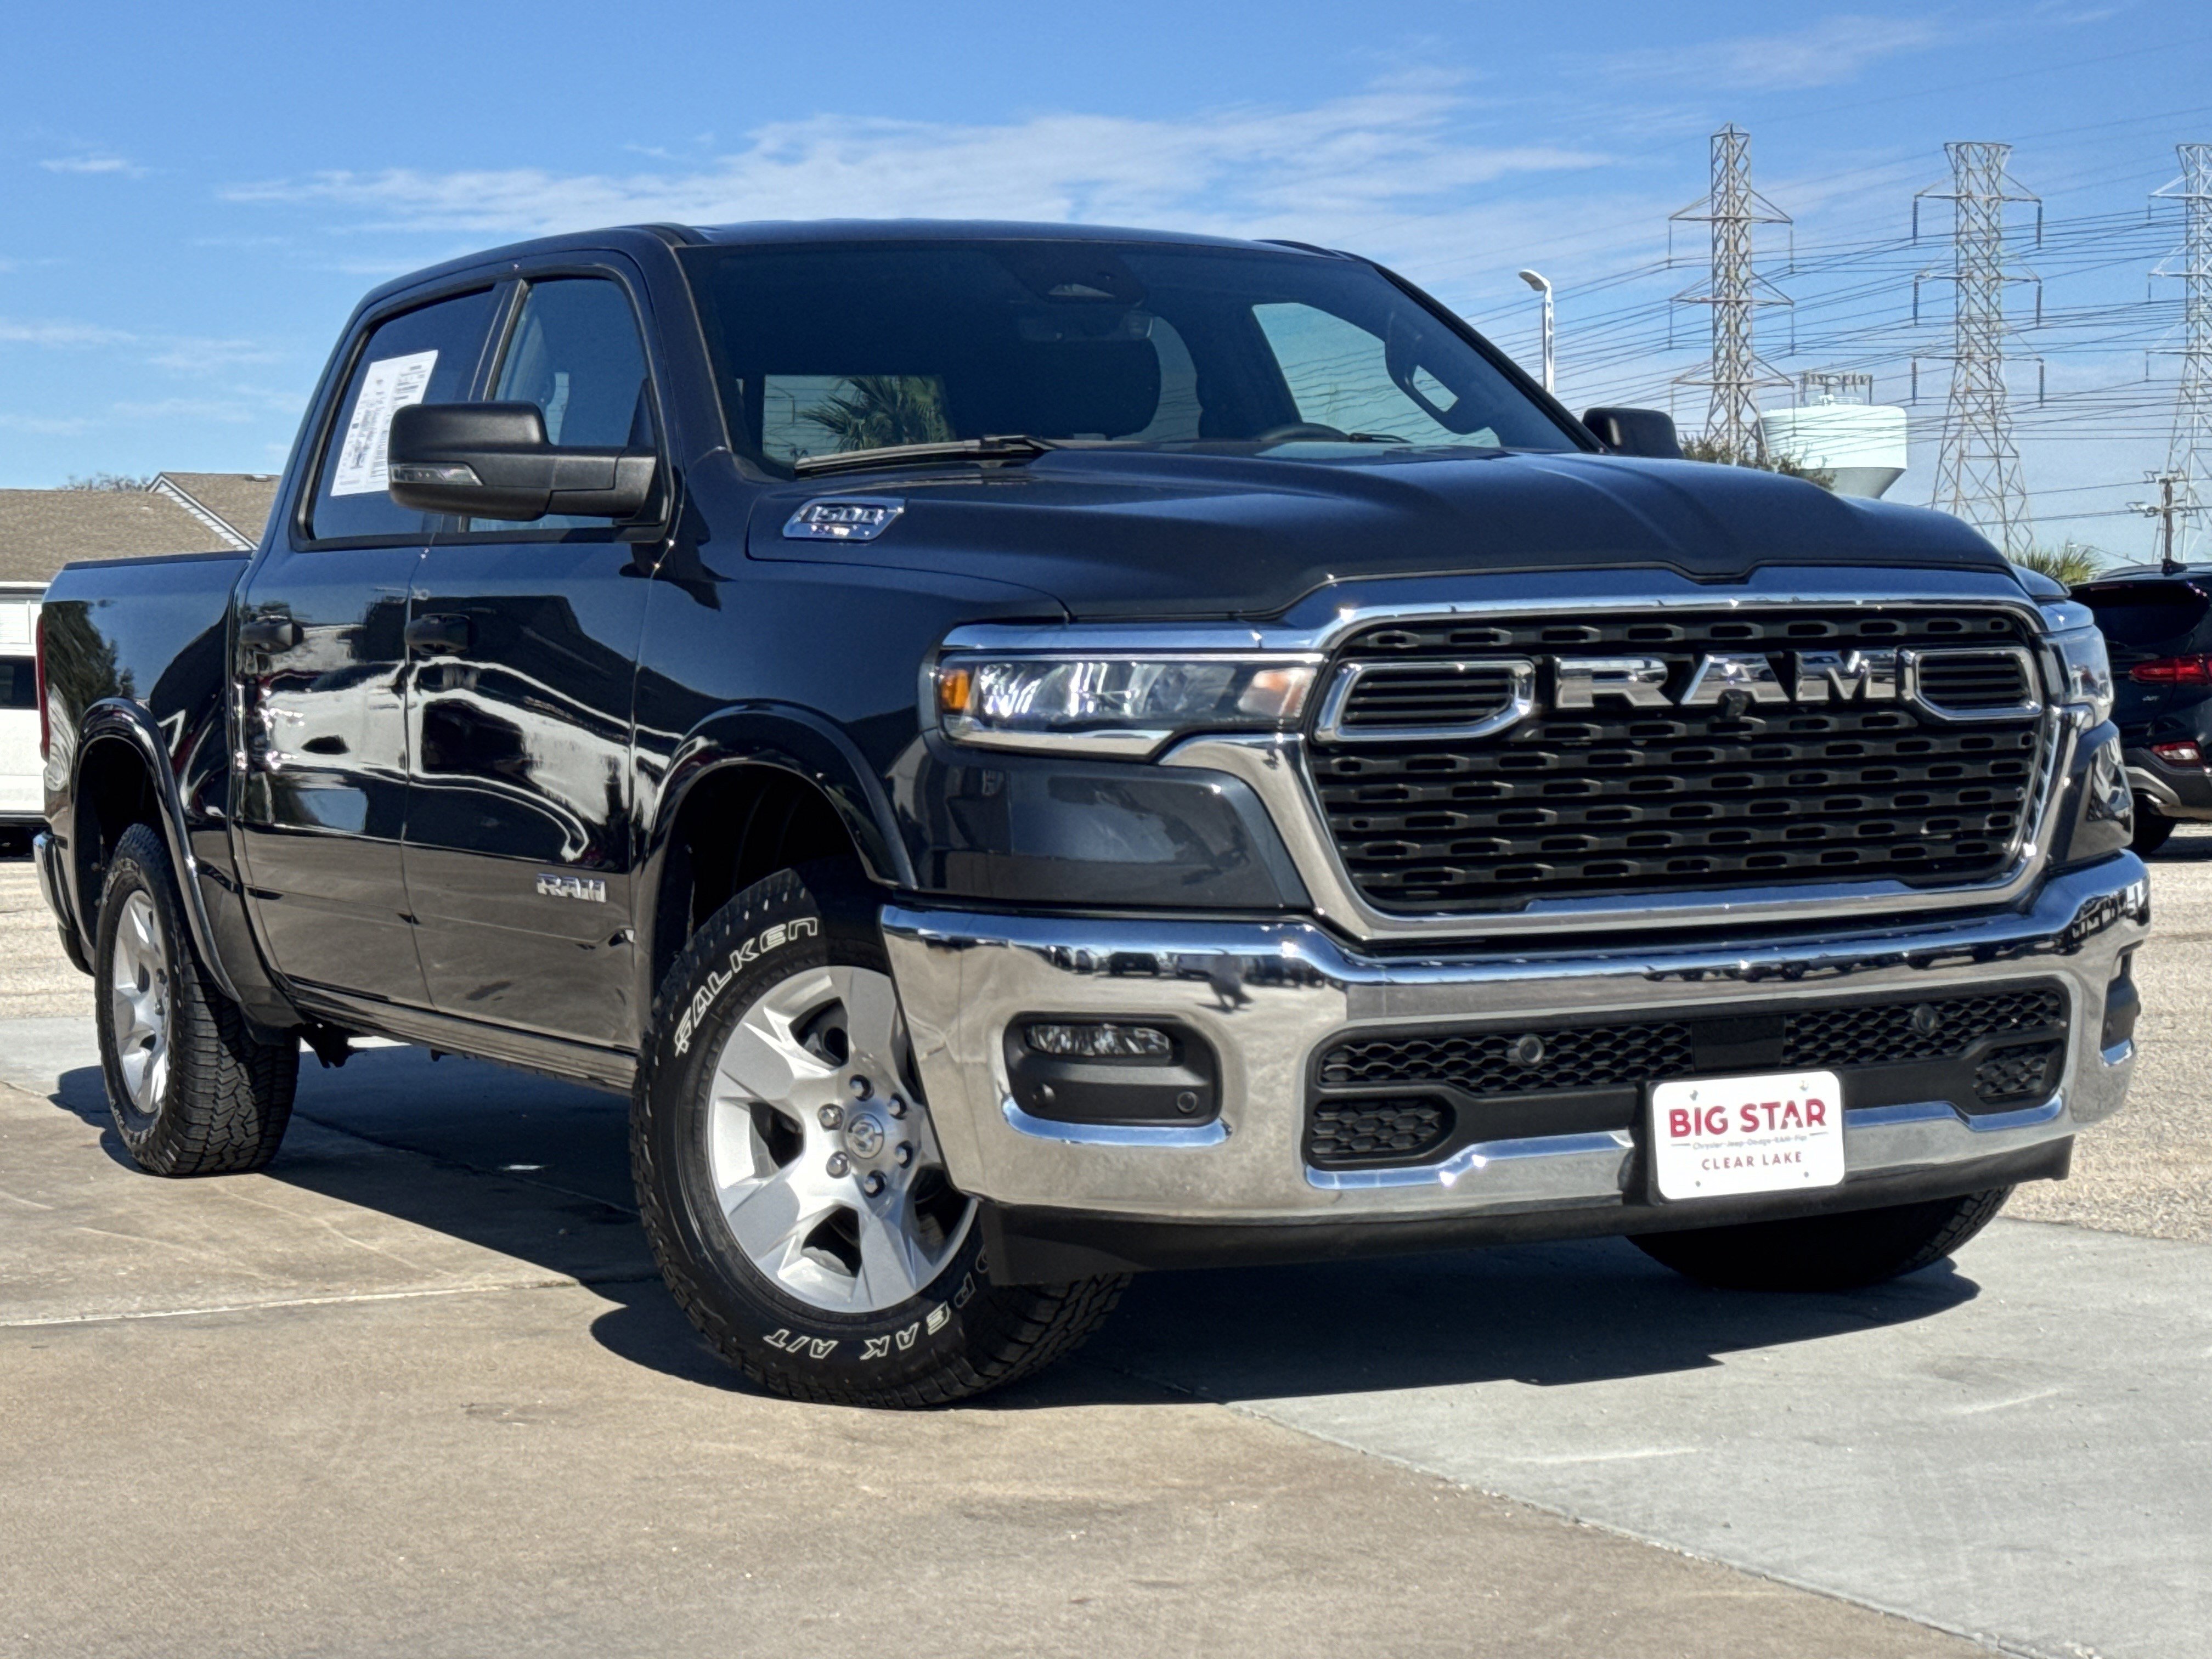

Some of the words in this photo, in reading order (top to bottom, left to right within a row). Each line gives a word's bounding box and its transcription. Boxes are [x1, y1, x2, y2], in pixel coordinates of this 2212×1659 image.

[1555, 650, 1897, 708] RAM
[536, 873, 607, 903] RAM
[674, 916, 819, 1058] FALKEN
[1668, 1105, 1729, 1138] BIG
[1739, 1098, 1826, 1133] STAR
[1701, 1155, 1755, 1171] CLEAR
[1762, 1151, 1802, 1166] LAKE
[763, 1328, 839, 1359] A/T
